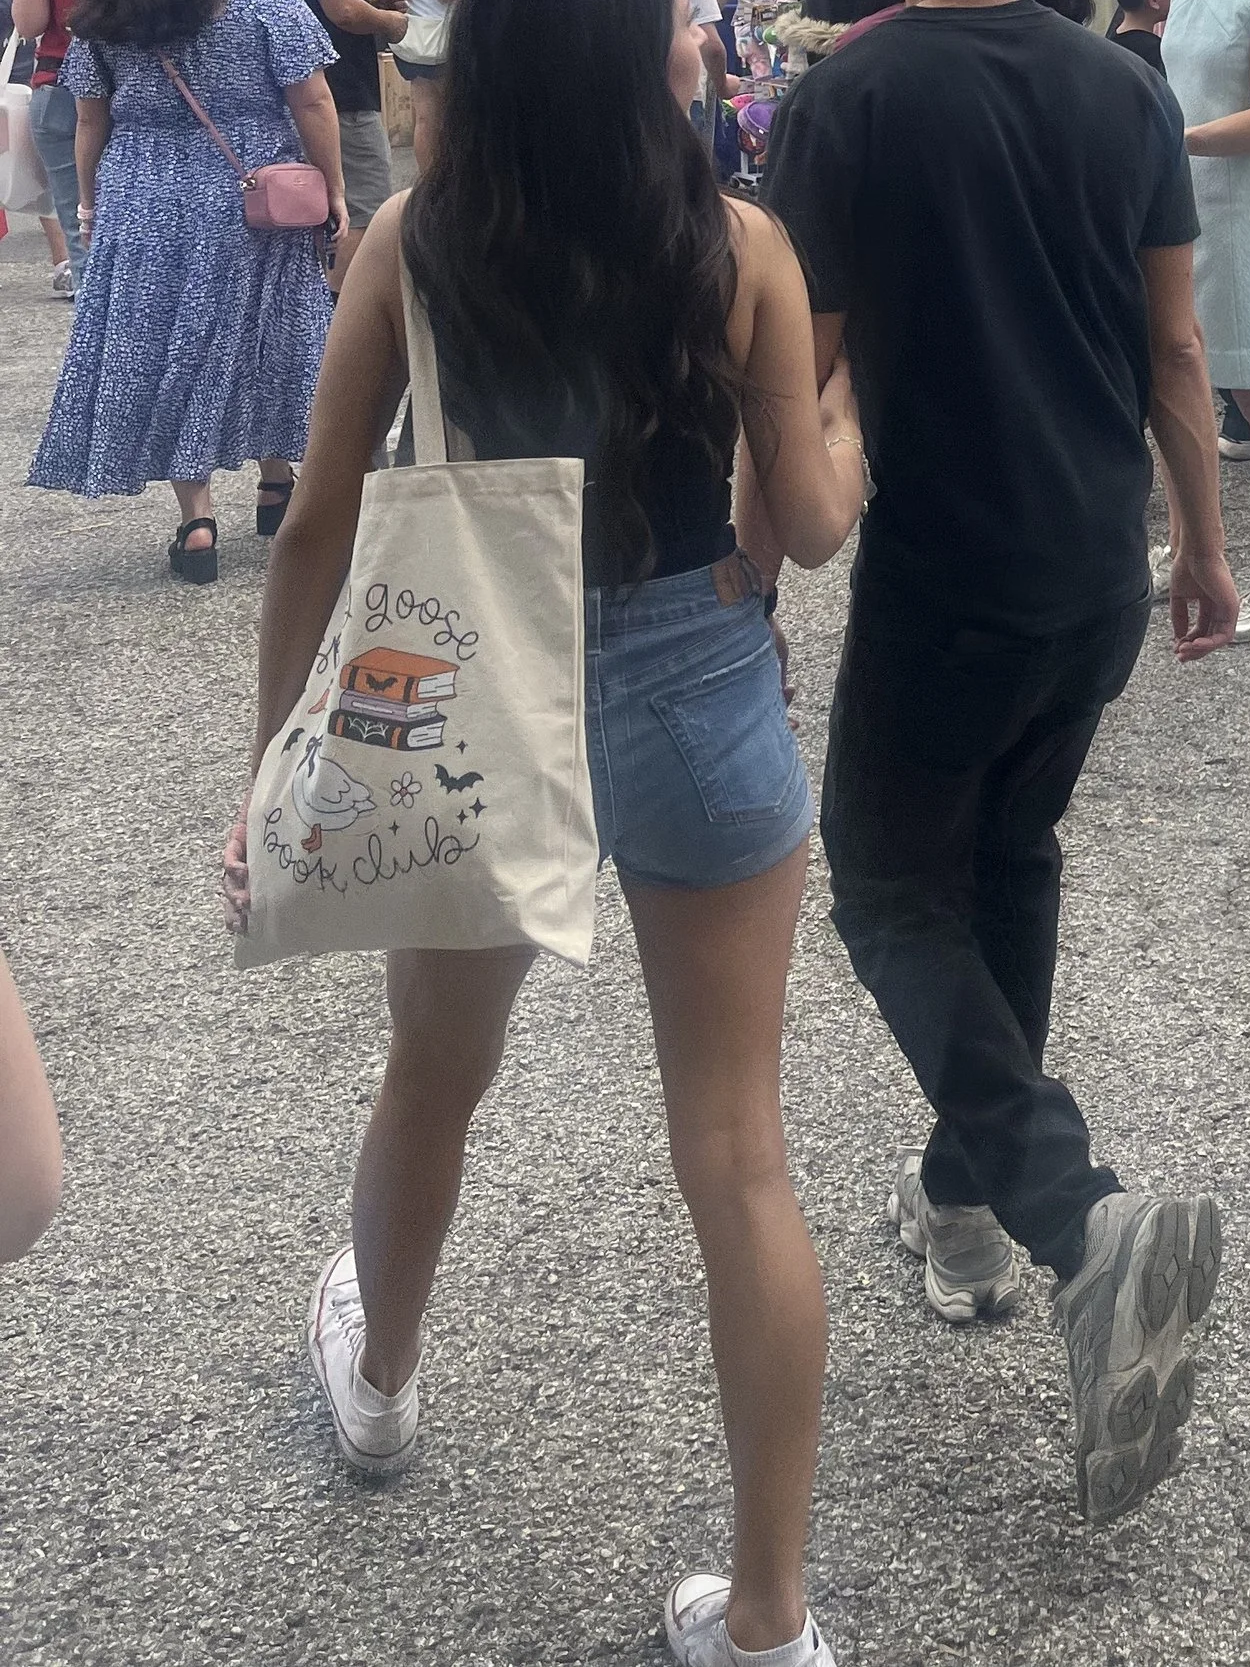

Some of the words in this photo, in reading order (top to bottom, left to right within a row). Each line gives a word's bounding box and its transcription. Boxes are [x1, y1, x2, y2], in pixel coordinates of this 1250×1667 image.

[365, 583, 479, 661] goose
[263, 807, 348, 894] book
[352, 816, 480, 885] club
